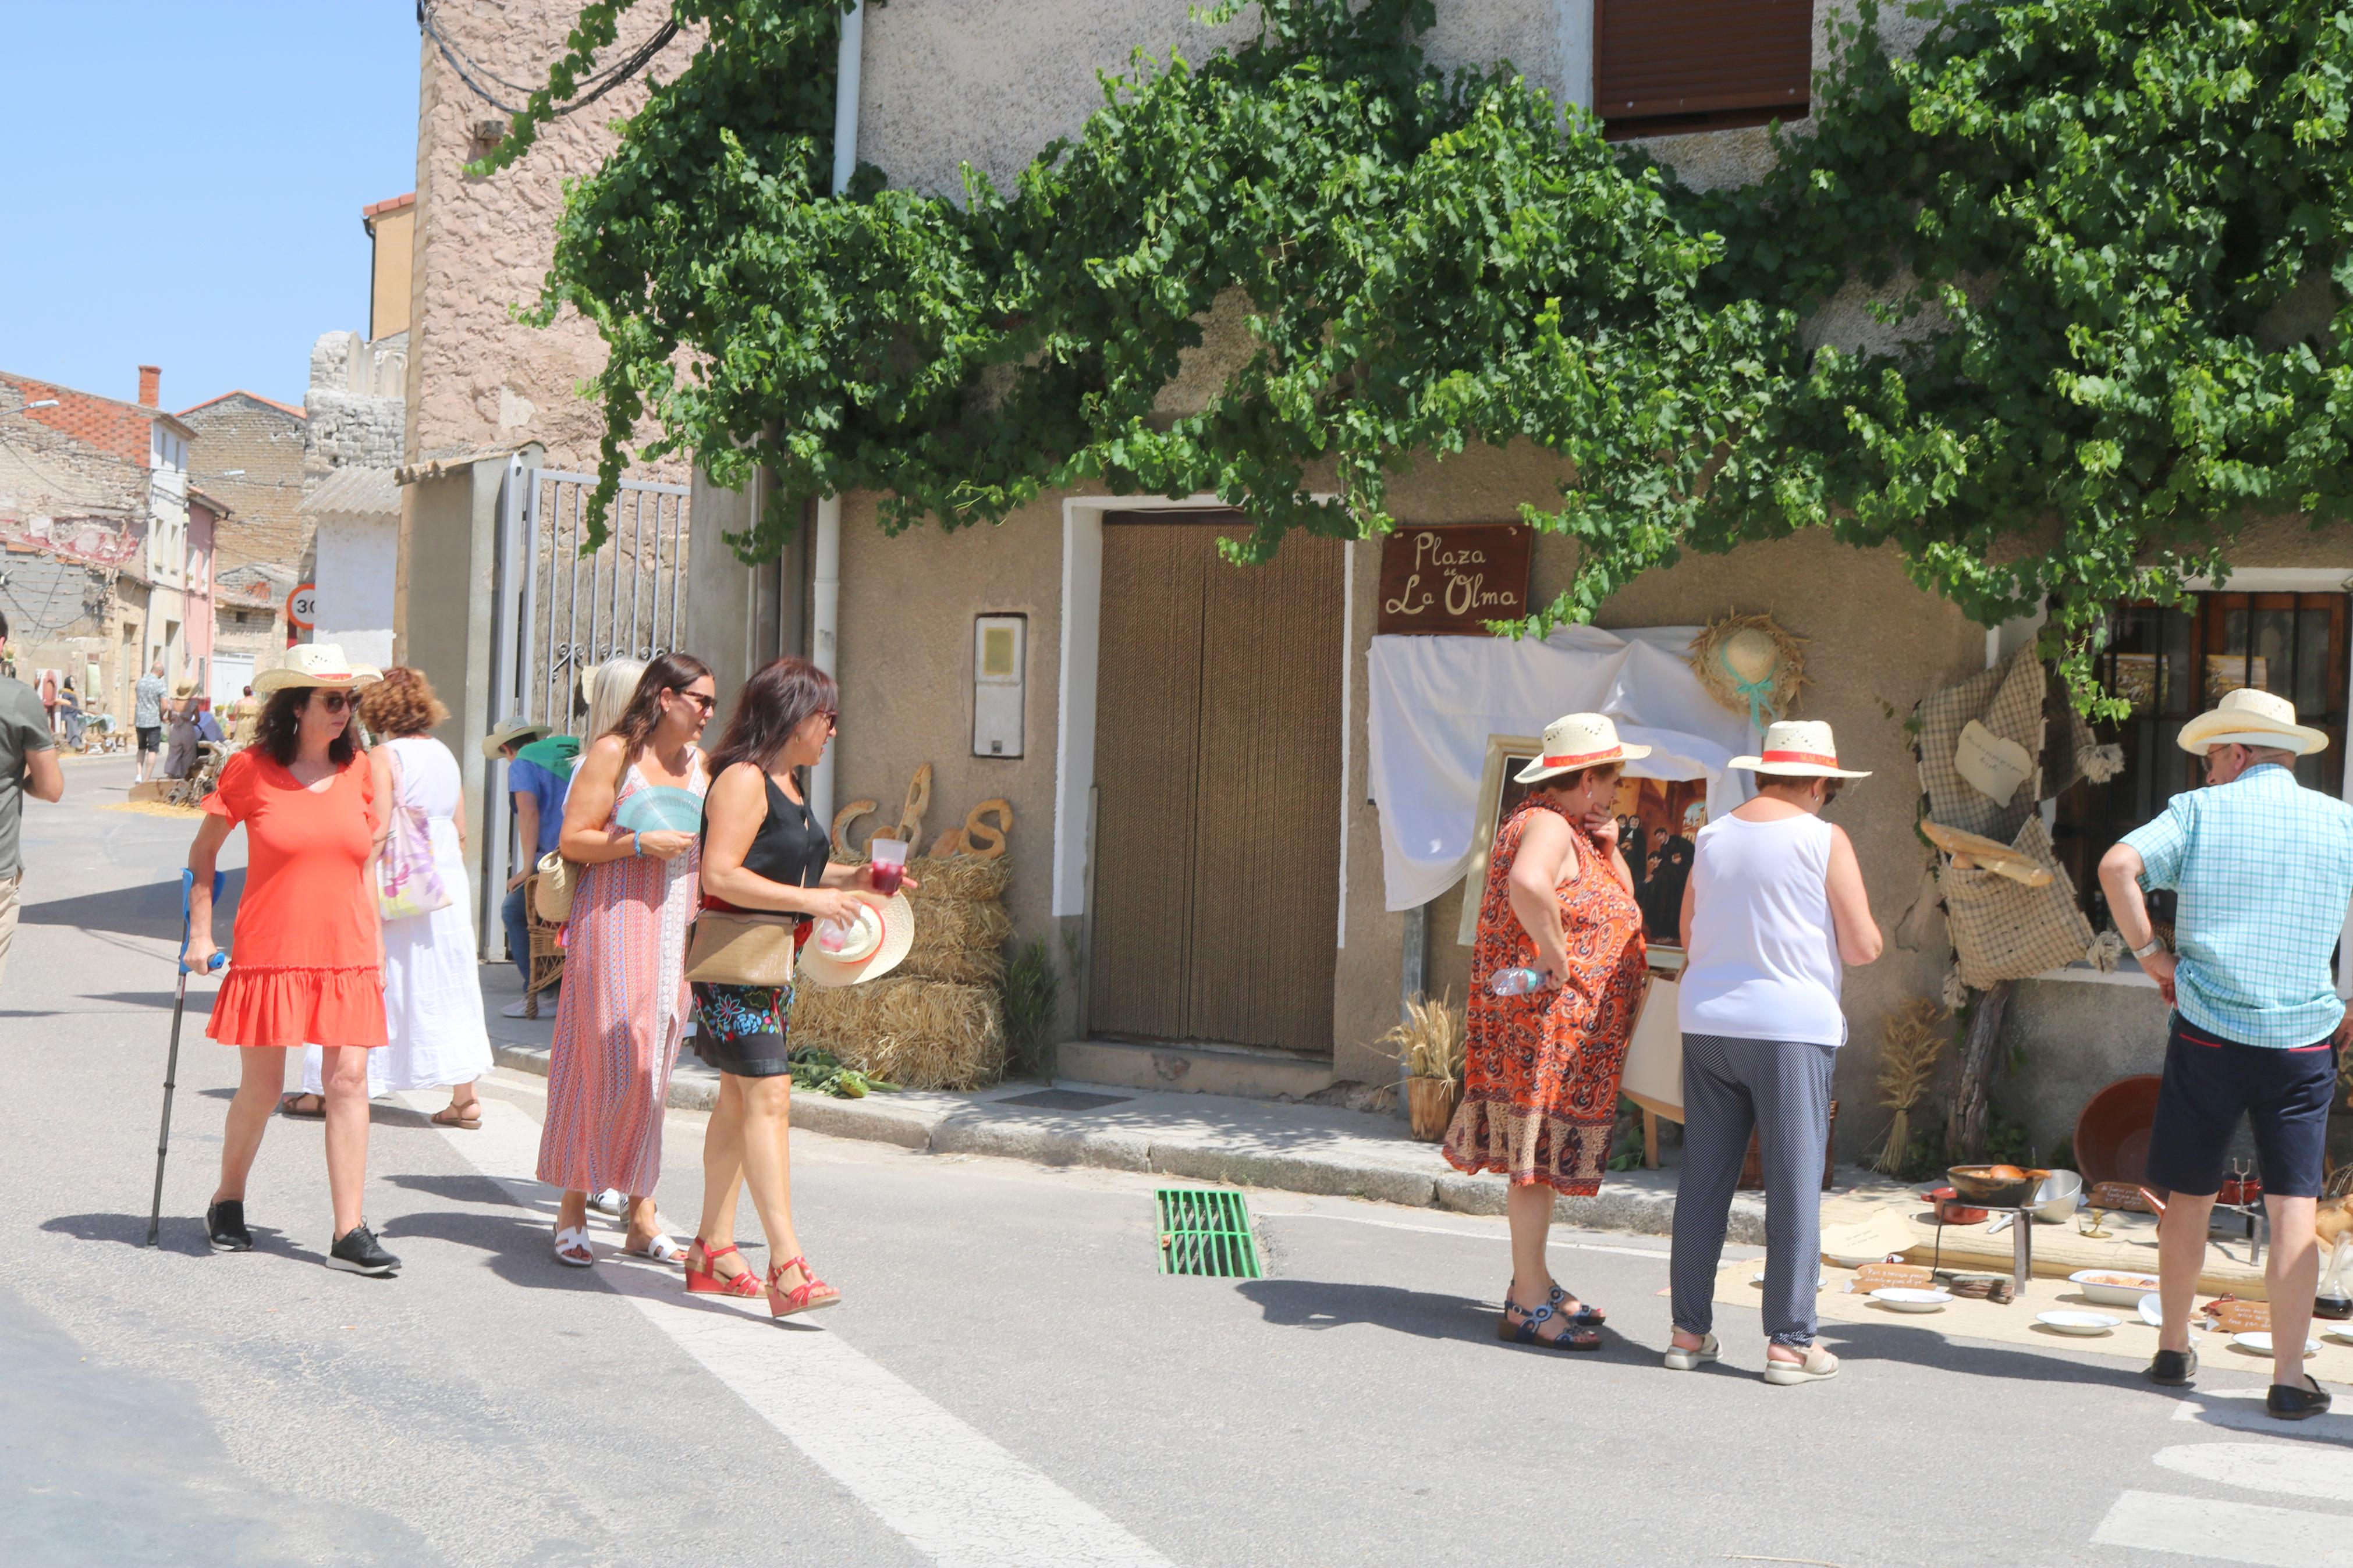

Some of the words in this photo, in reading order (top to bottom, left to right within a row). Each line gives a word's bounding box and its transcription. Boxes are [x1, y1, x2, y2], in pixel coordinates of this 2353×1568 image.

[1413, 532, 1486, 571] Plaza
[1444, 568, 1457, 577] de
[1386, 574, 1435, 614] La
[1445, 573, 1518, 615] Olma
